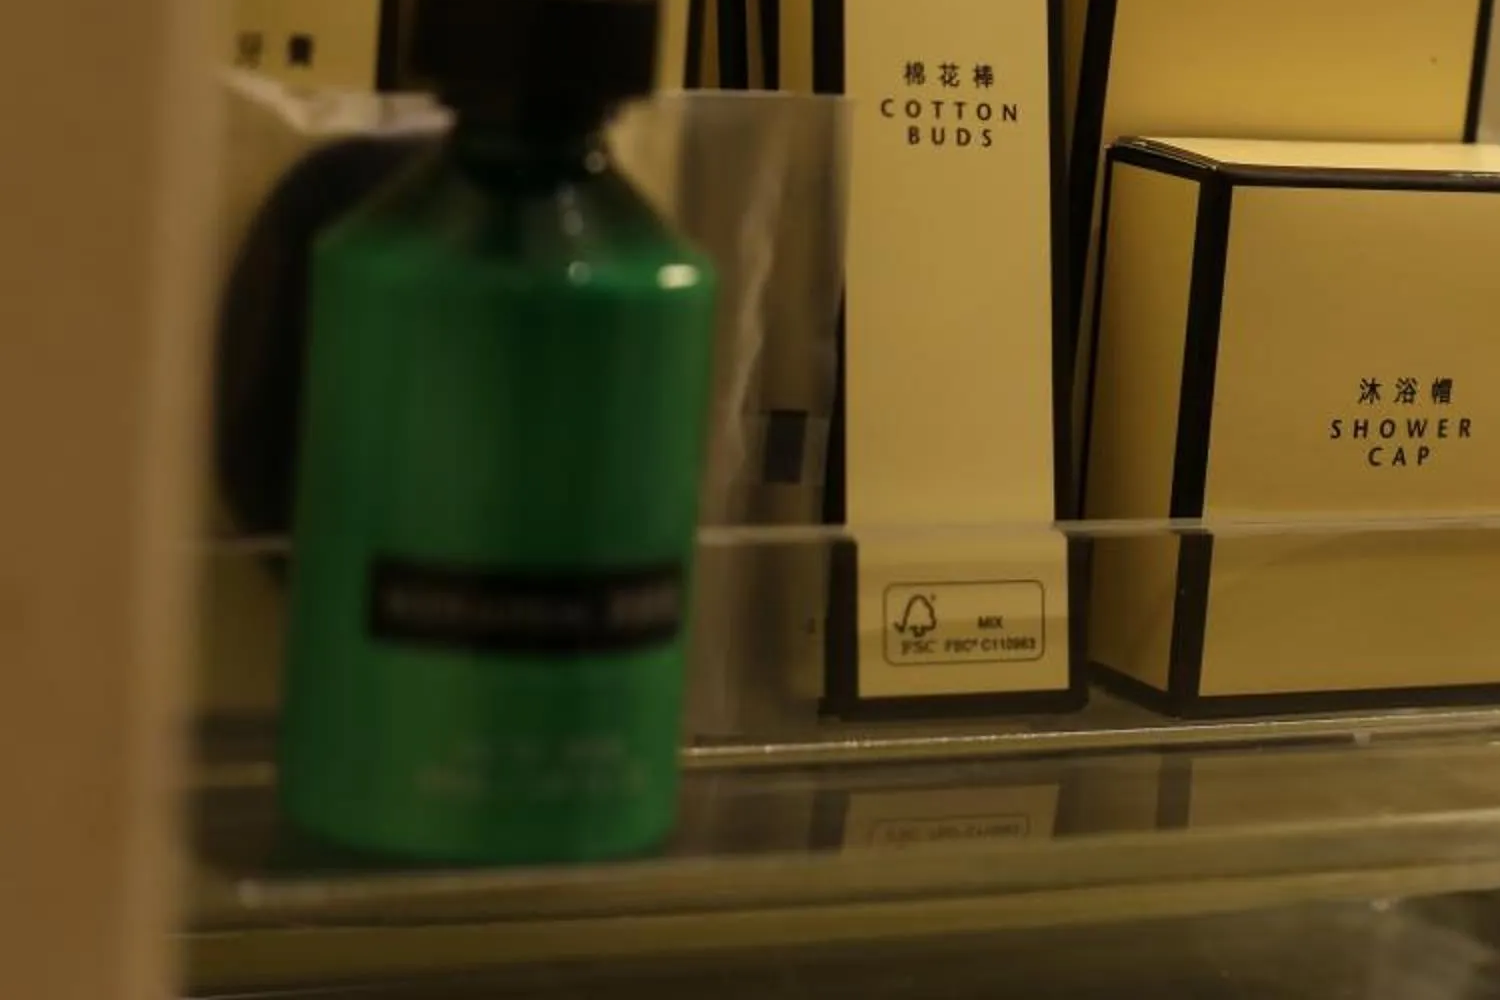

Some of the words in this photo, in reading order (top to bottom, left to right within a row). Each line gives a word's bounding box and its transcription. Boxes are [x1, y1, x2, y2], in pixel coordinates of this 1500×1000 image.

[903, 60, 995, 88] 棉花棒
[880, 98, 1018, 122] COTTON
[907, 125, 992, 147] BUDS
[1357, 376, 1453, 405] 沐浴帽
[1329, 418, 1472, 440] SHOWER
[1367, 445, 1431, 467] CAP
